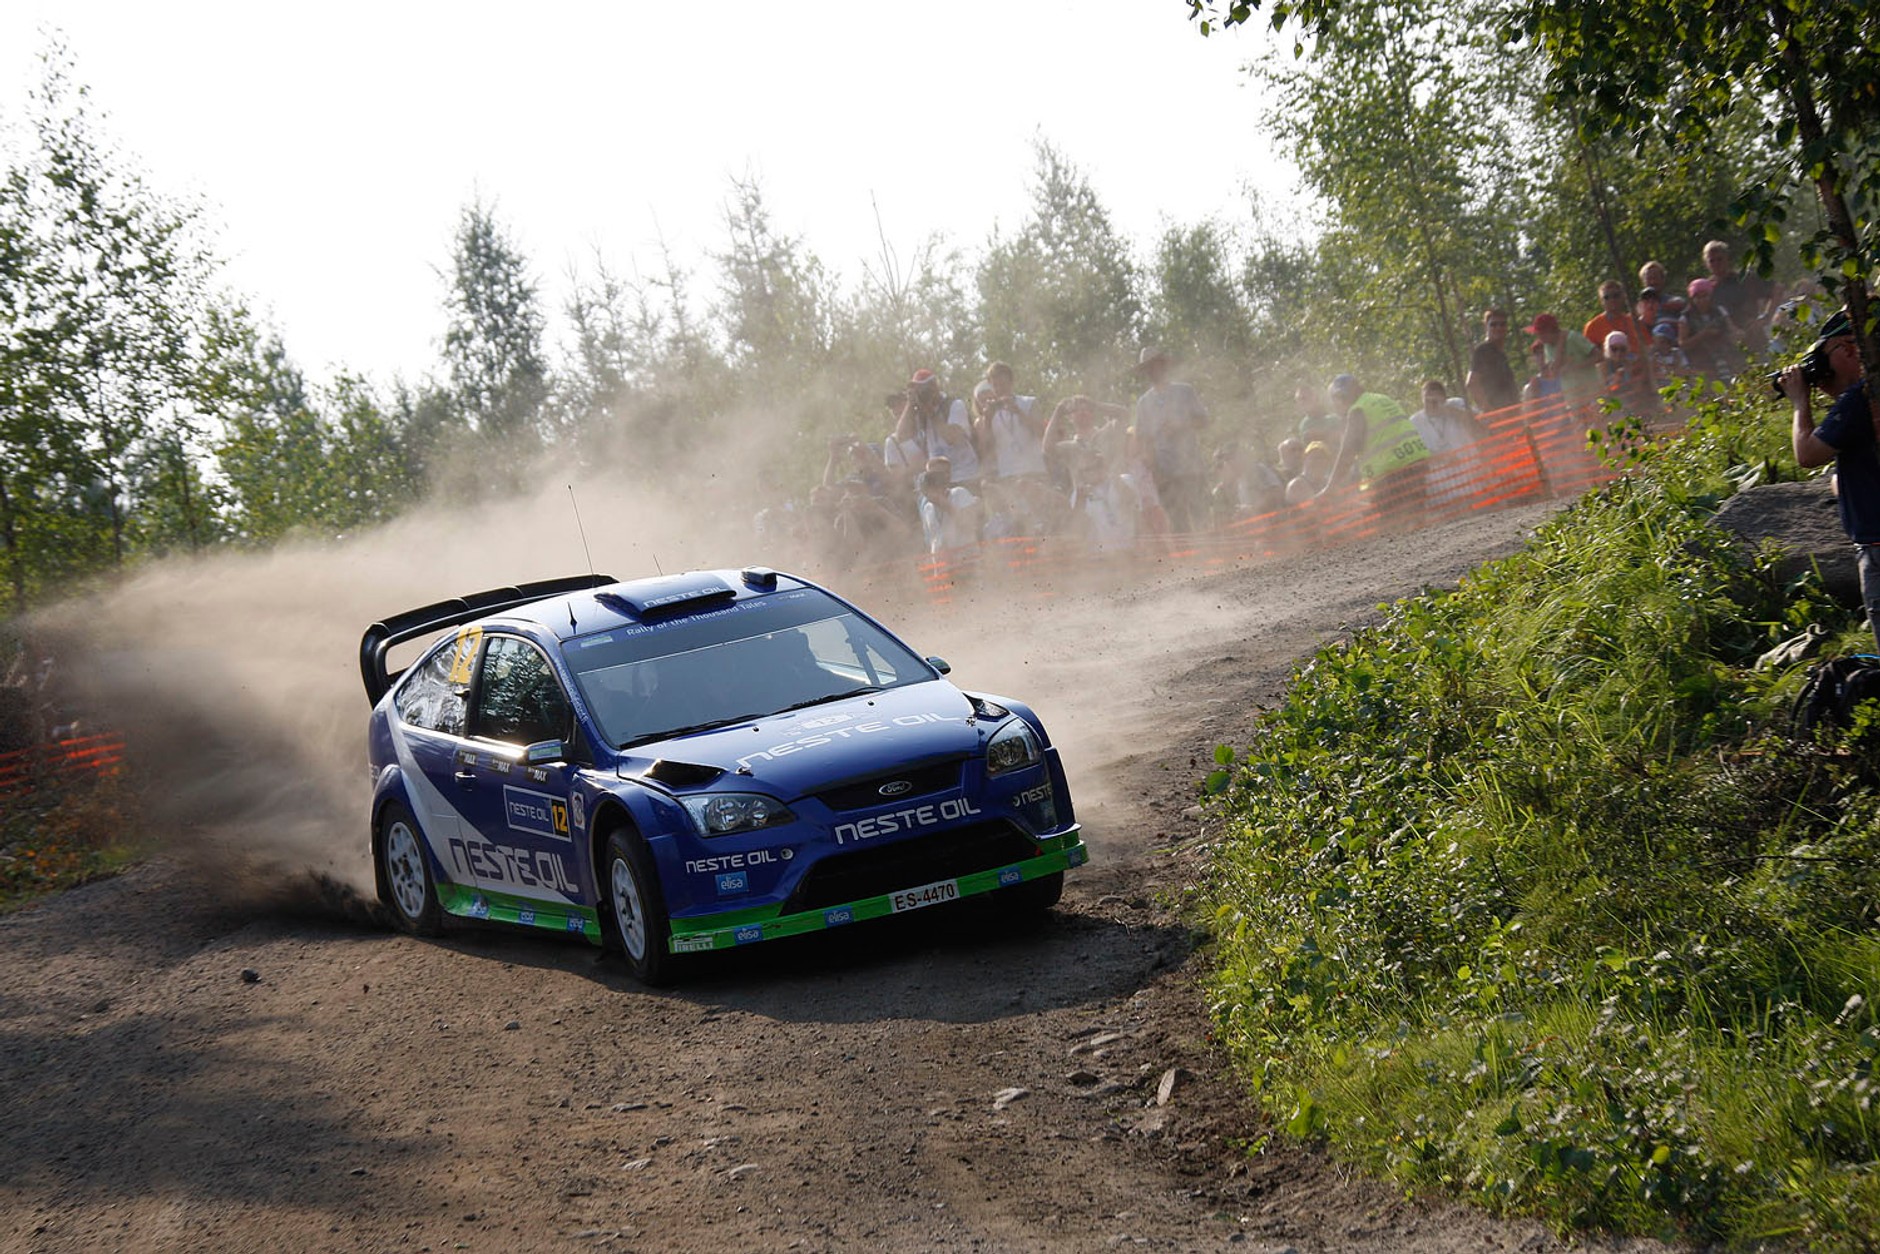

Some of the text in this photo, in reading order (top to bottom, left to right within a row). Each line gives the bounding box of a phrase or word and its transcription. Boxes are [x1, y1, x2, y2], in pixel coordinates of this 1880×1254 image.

[643, 586, 723, 608] NESTE OIL
[626, 600, 767, 636] Rally of the Thousand Tales
[448, 624, 483, 684] 12
[736, 720, 890, 768] NESTE
[892, 712, 961, 727] OIL
[509, 801, 549, 823] NESTE OIL
[552, 805, 568, 833] 12
[834, 798, 981, 844] NESTE OIL
[448, 838, 579, 894] NESTE OIL
[685, 849, 777, 874] NESTE OIL
[720, 874, 744, 890] elisa
[895, 882, 955, 911] ES-4470
[828, 909, 850, 924] elisa
[737, 928, 759, 942] elisa
